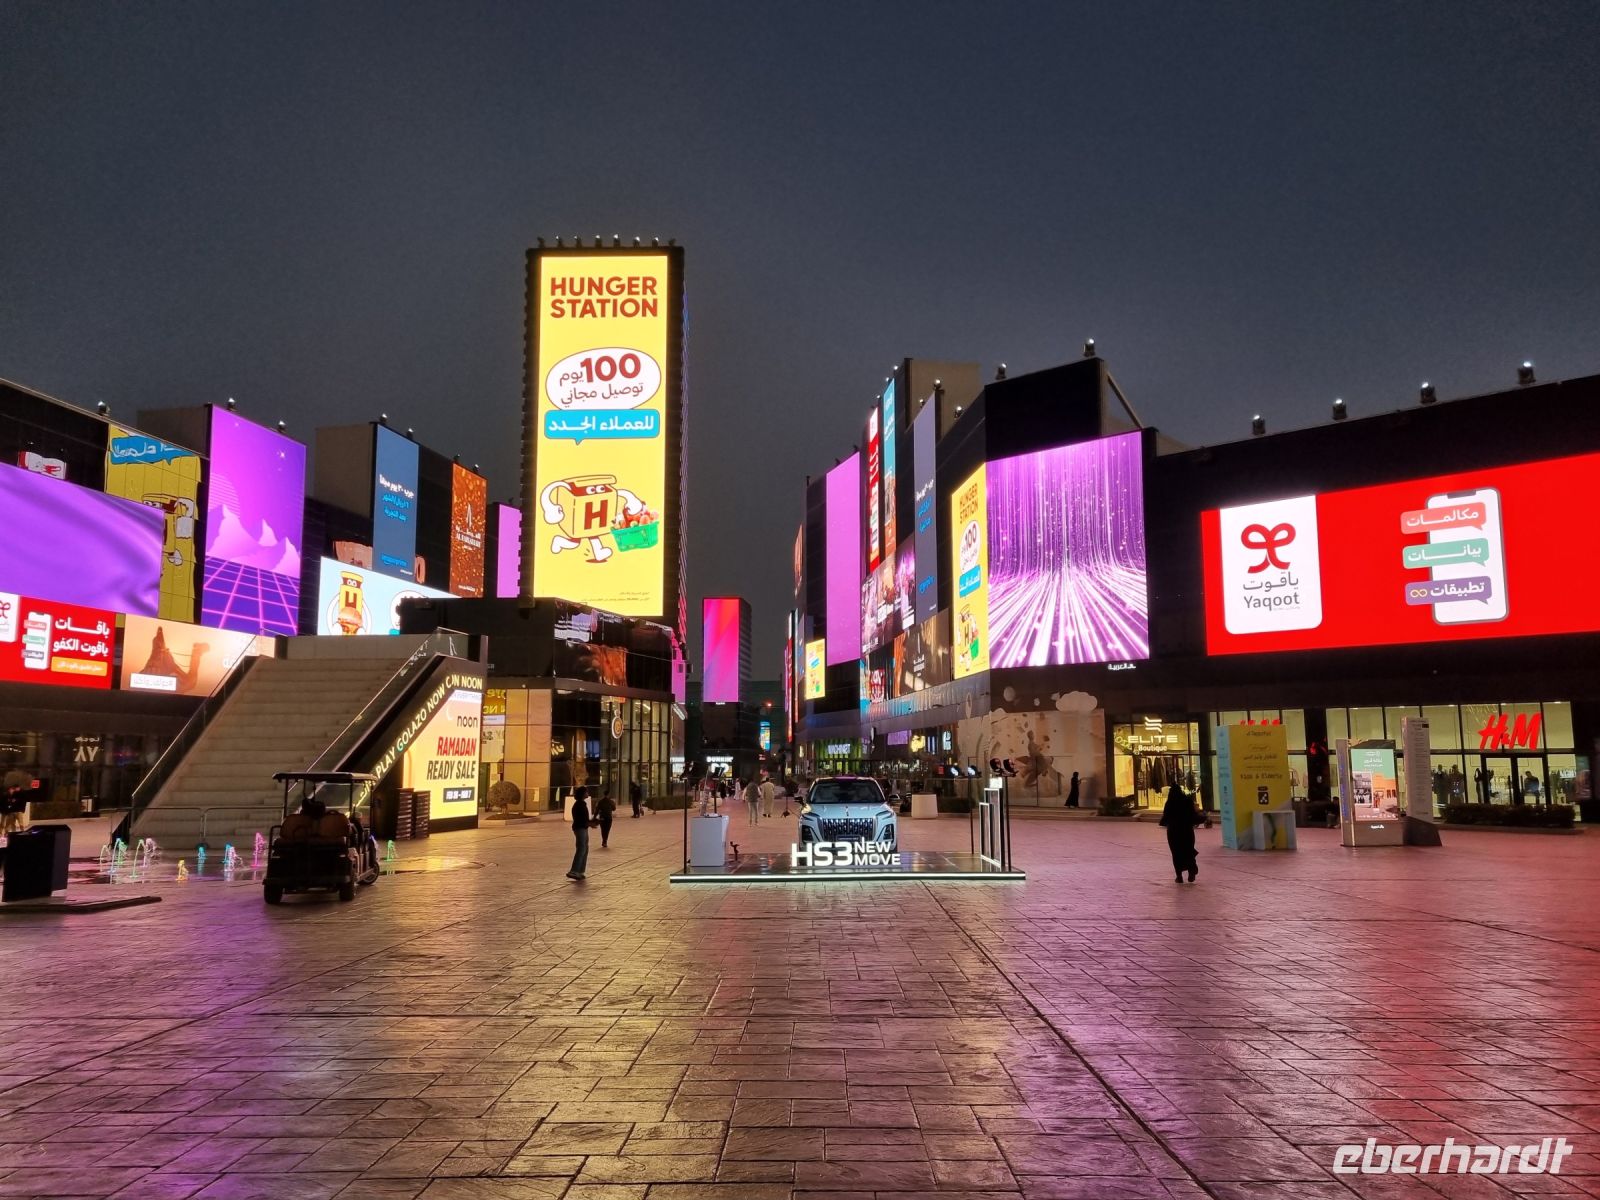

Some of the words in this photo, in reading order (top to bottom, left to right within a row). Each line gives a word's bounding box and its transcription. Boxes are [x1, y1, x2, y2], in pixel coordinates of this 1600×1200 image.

[550, 276, 658, 297] HUNGER
[550, 298, 658, 318] STATION
[580, 353, 641, 383] 100
[559, 369, 584, 387] يوم
[560, 387, 597, 409] مجاني
[601, 382, 644, 400] توصيل
[548, 416, 596, 434] الجدد
[600, 415, 655, 431] للعملاء
[584, 499, 609, 531] H
[1406, 507, 1480, 527] مكالمات
[1407, 543, 1482, 562] بيانات
[1242, 571, 1299, 592] ياقوت
[1430, 582, 1485, 597] تطبيقات
[1243, 592, 1300, 611] Yaqoot
[54, 616, 110, 639] باقات
[53, 637, 79, 652] الكفو
[80, 640, 109, 657] ياقوت
[375, 747, 397, 779] PLAY
[396, 708, 427, 751] GOLAZO
[427, 683, 445, 713] NOW
[461, 675, 483, 690] NOON
[457, 715, 478, 728] noon
[1127, 735, 1178, 743] ELITE
[1477, 712, 1543, 751] H&M
[437, 736, 477, 757] RAMADAN
[1138, 744, 1168, 753] Boutique
[427, 762, 455, 780] READY
[456, 760, 475, 779] SALE
[791, 841, 853, 867] HS3
[854, 841, 892, 853] NEW
[854, 853, 901, 866] MOVE
